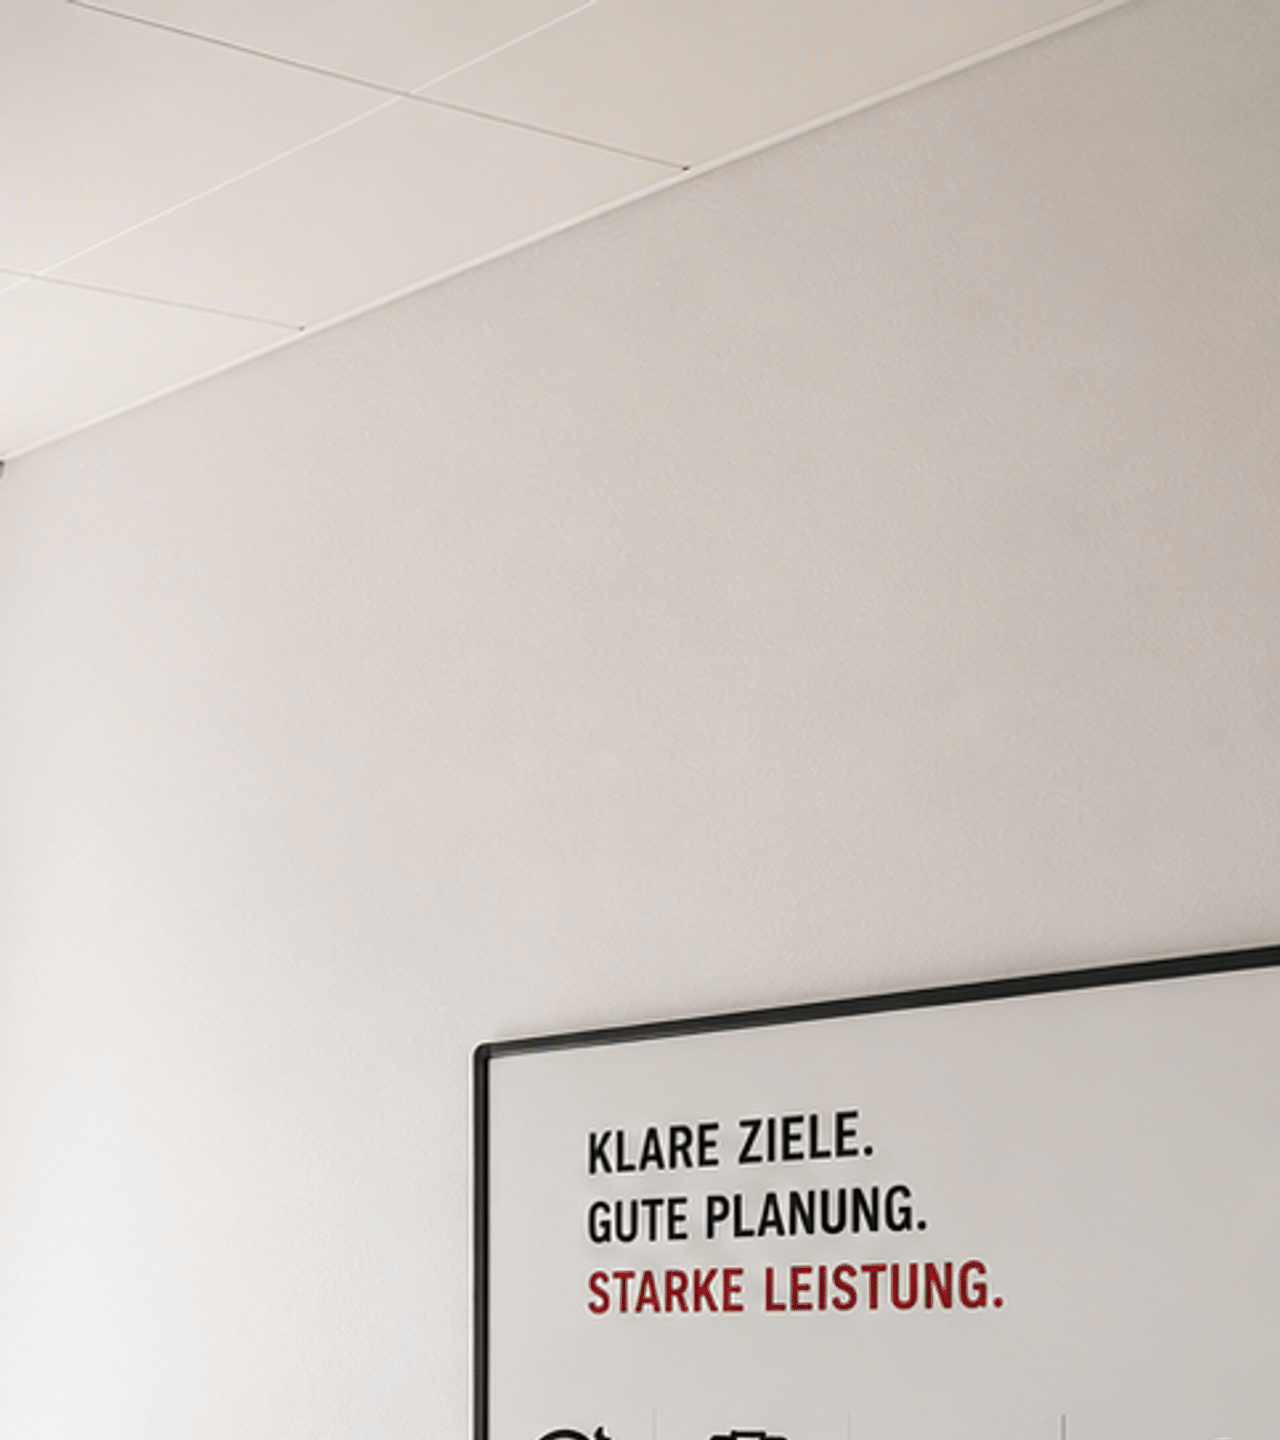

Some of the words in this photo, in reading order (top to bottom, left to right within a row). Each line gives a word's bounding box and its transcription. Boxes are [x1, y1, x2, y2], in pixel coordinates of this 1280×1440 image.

[589, 1122, 719, 1175] KLARE
[738, 1110, 873, 1165] ZIELE.
[588, 1197, 688, 1244] GUTE
[707, 1185, 927, 1239] PLANUNG.
[588, 1268, 744, 1314] STARKE
[765, 1260, 1003, 1312] LEISTUNG.
